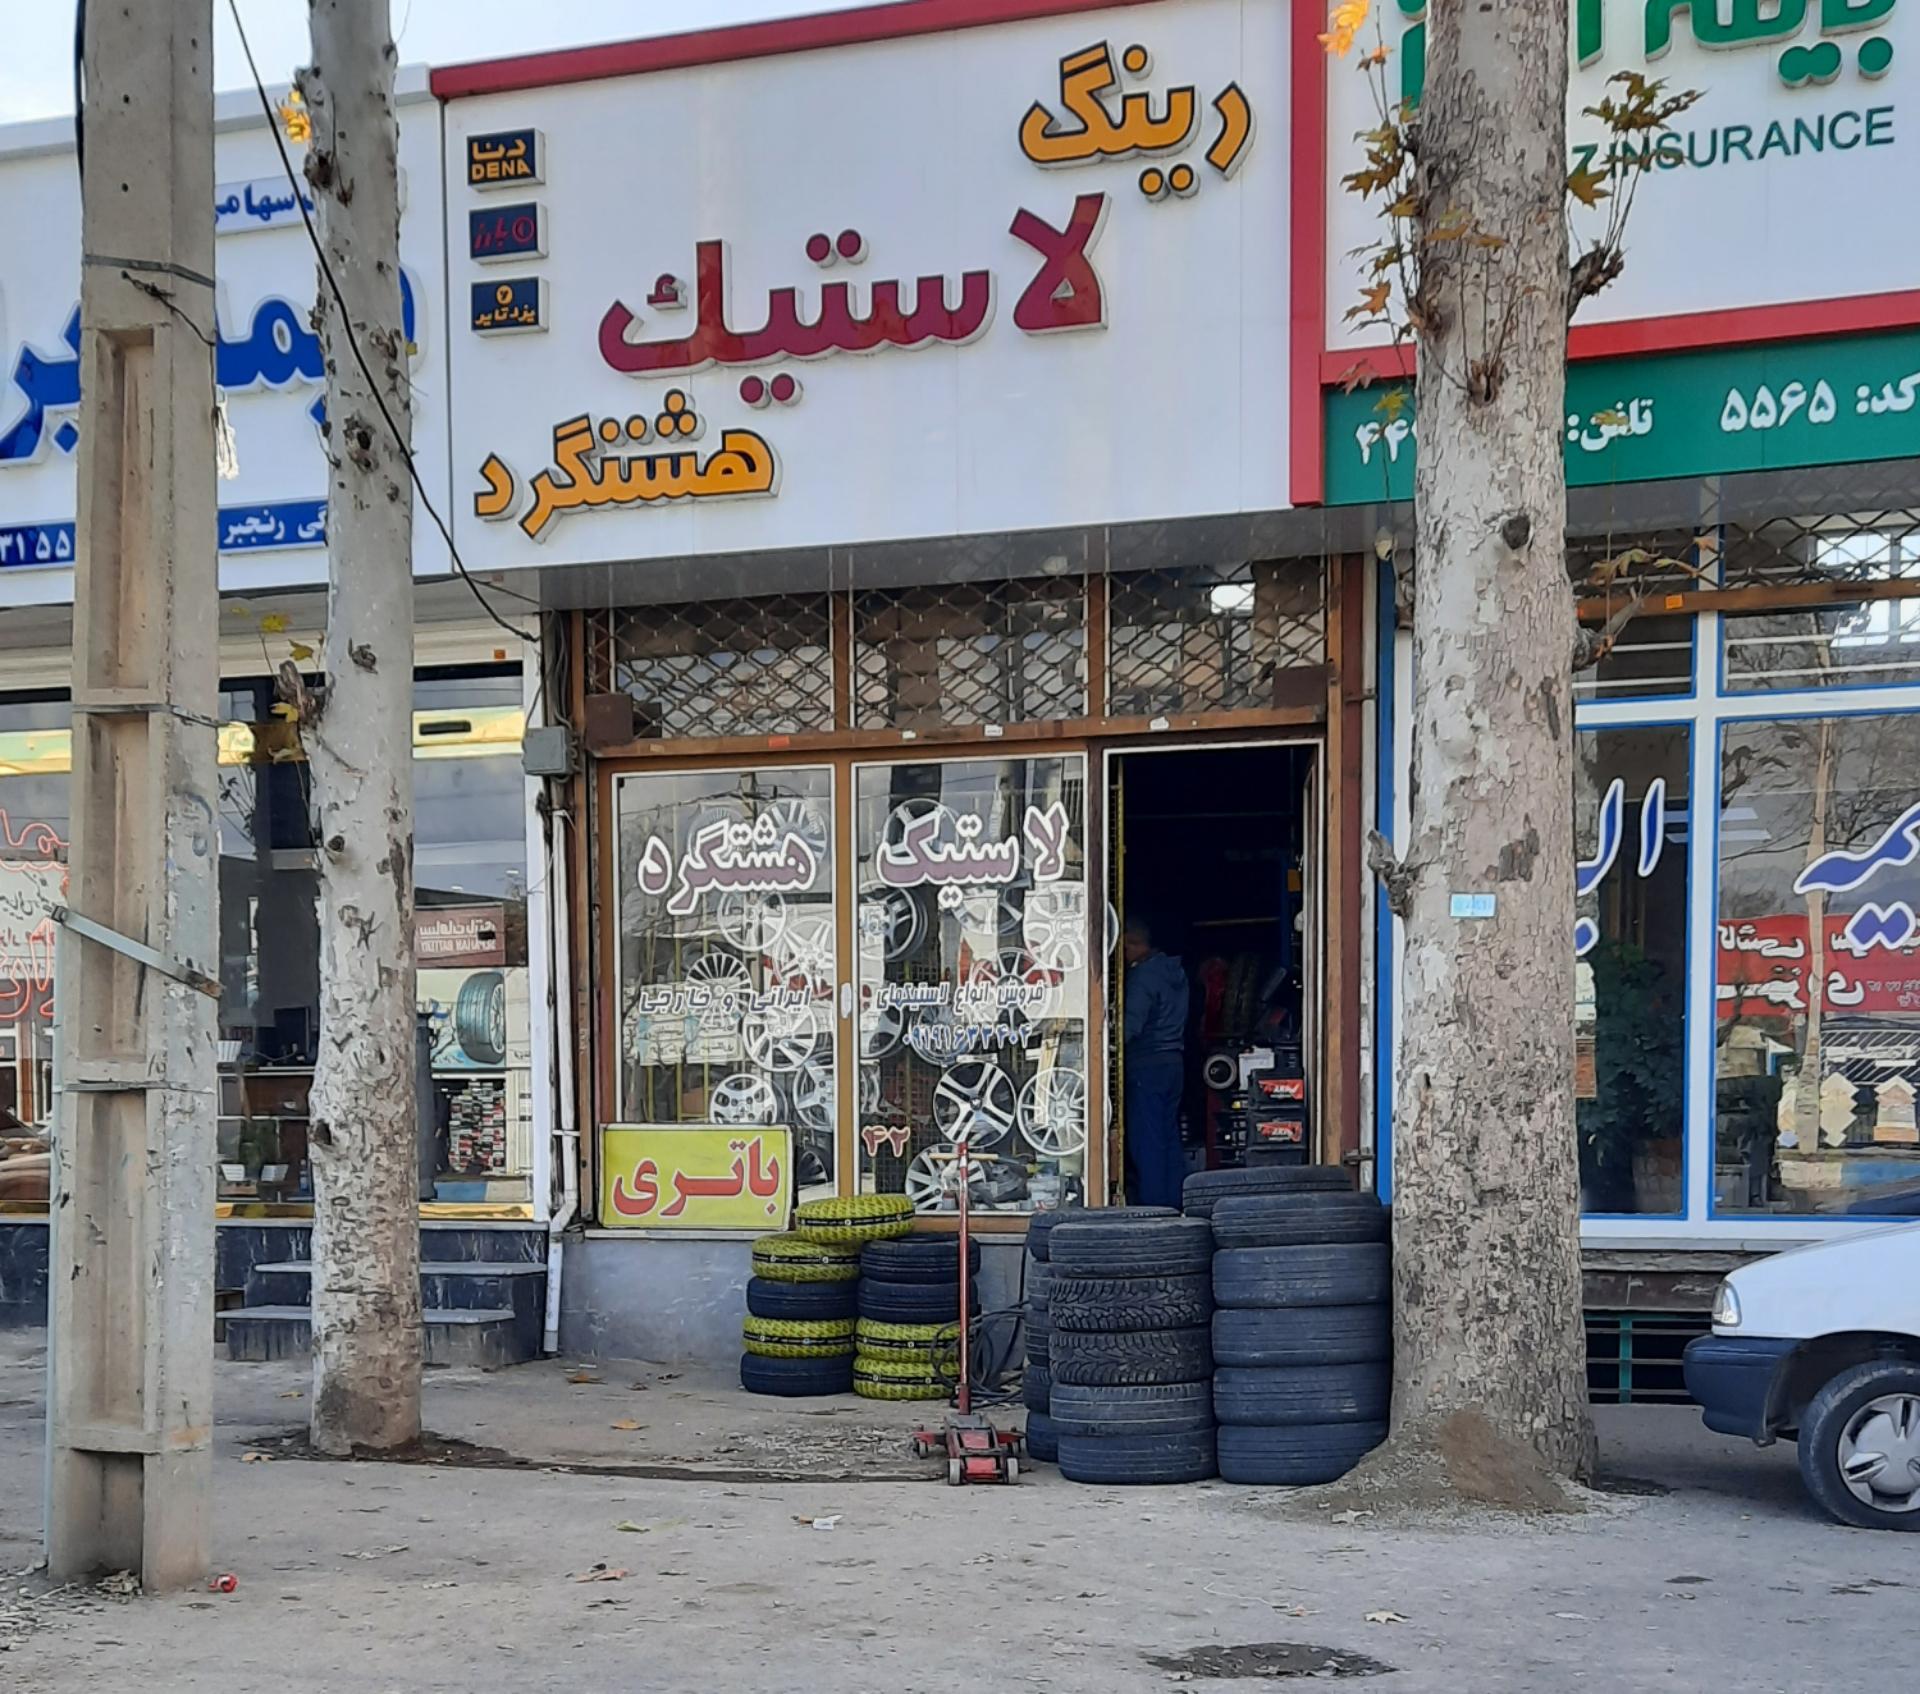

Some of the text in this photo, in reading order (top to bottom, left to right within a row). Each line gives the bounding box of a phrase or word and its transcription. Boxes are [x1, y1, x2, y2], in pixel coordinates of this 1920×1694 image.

[1019, 40, 1254, 200] رینگ
[1610, 105, 1895, 179] INSURANCE
[472, 139, 527, 160] دنا
[472, 159, 531, 181] DENA
[214, 182, 296, 224] سهام
[1720, 379, 1837, 431] ۵۵۶۵
[1354, 418, 1417, 464] ۴۴
[474, 388, 781, 542] هشتگرد
[223, 509, 285, 544] رنجبر
[877, 800, 1069, 908] لاستیک
[639, 985, 812, 1014] ایرانی و خارجی
[877, 976, 1046, 1015] فروش انواع لاستیکهای
[612, 1136, 781, 1217] باتری
